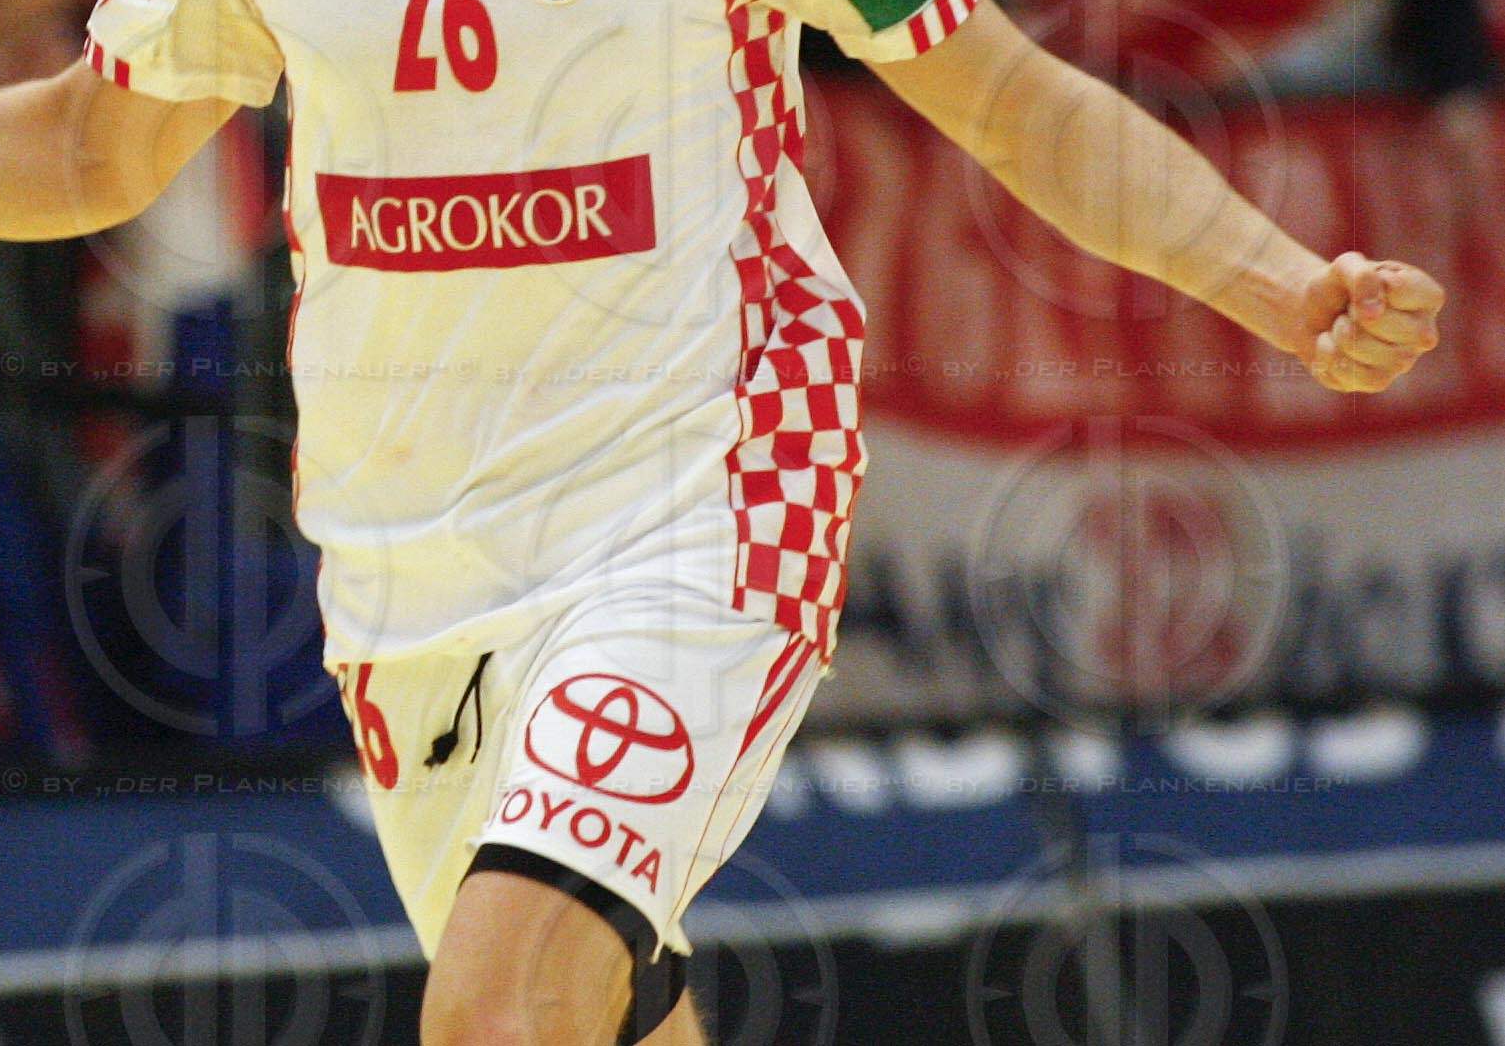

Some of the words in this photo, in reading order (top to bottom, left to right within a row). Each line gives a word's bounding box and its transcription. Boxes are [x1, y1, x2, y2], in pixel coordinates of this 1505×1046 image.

[351, 184, 613, 254] AGROKOR
[338, 663, 399, 790] 6
[489, 788, 662, 895] OYOTA
